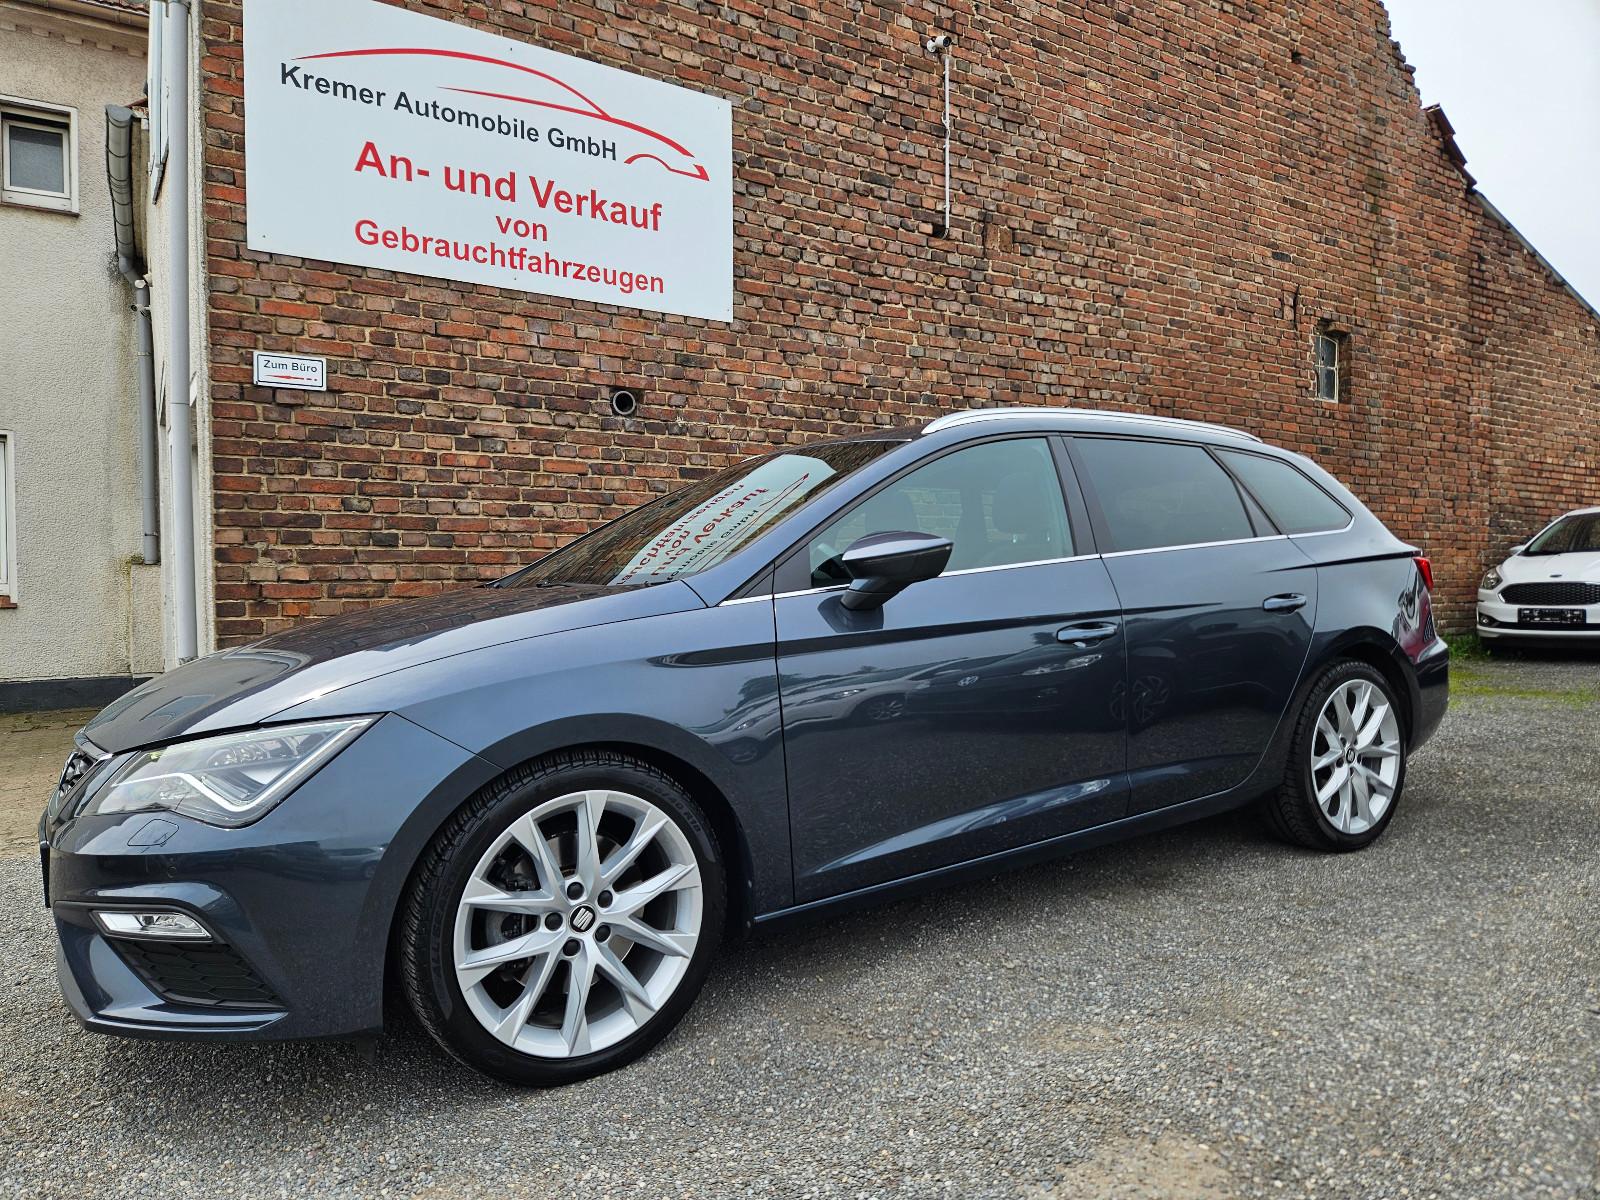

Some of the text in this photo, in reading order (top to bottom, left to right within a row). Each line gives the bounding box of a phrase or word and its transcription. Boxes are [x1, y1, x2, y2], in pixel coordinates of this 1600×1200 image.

[280, 62, 617, 161] Kremer Automobile GmbH
[354, 141, 663, 232] An- und Verkauf
[354, 219, 665, 294] Gebrauchtfahrzeugen
[495, 215, 548, 242] von
[263, 359, 318, 373] Zum Büro
